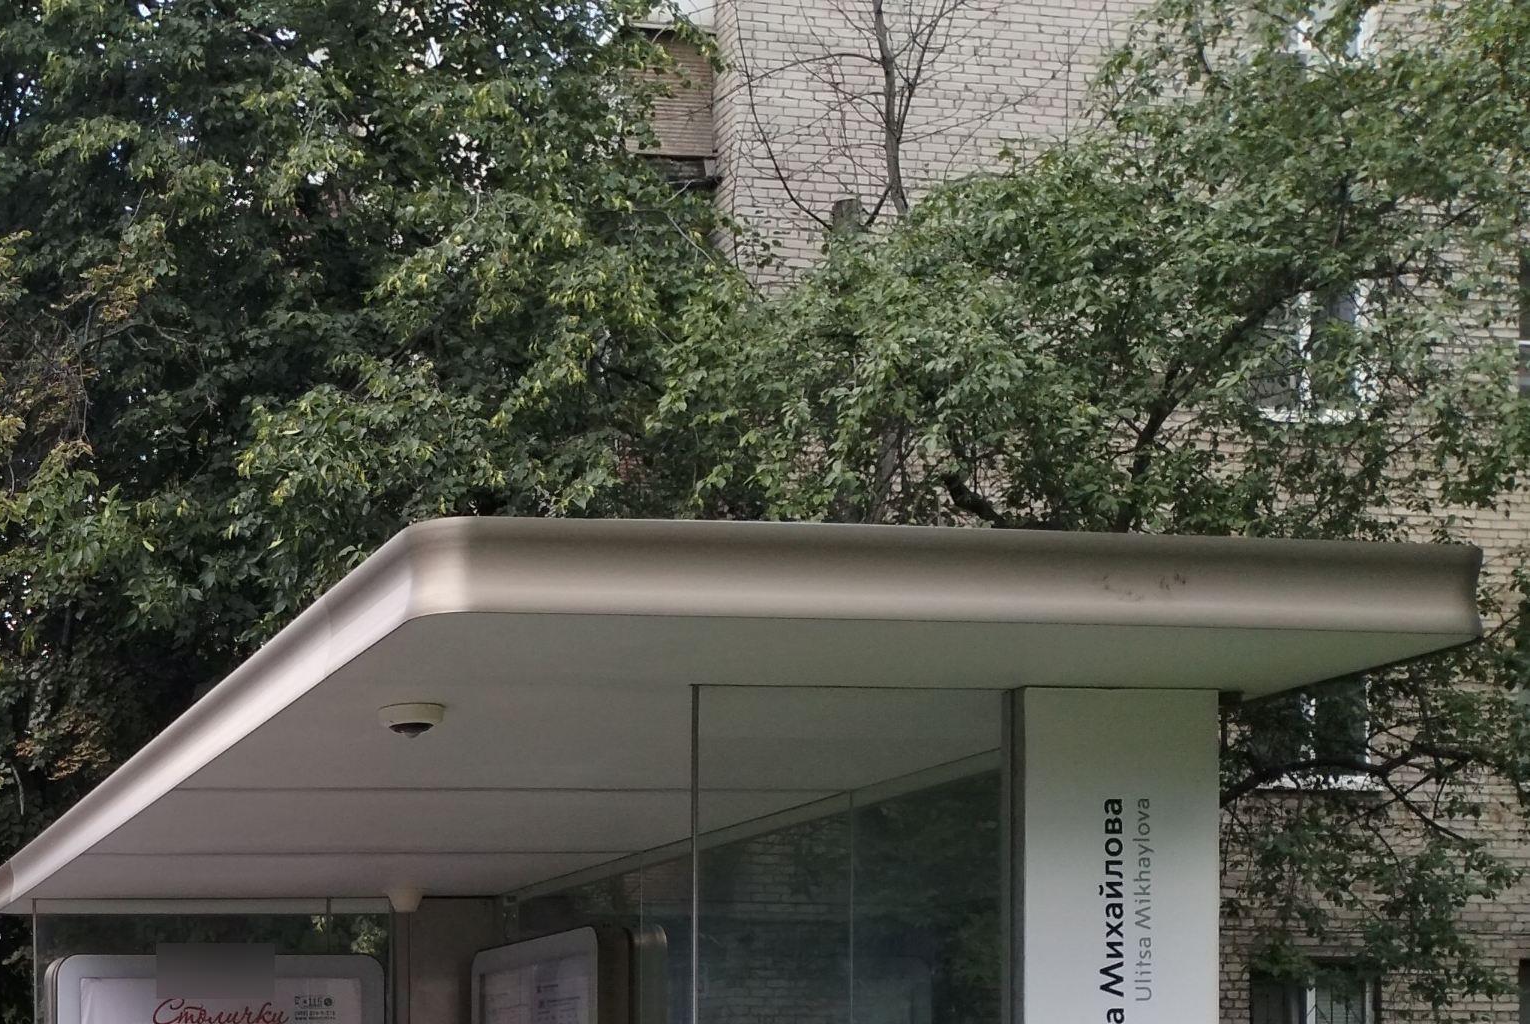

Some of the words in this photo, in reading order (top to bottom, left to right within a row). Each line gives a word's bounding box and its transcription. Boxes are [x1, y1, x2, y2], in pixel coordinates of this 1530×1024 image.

[1098, 798, 1125, 998] Михайлова
[1133, 797, 1155, 930] Mikhaylova
[1134, 936, 1152, 1002] Ulitsa
